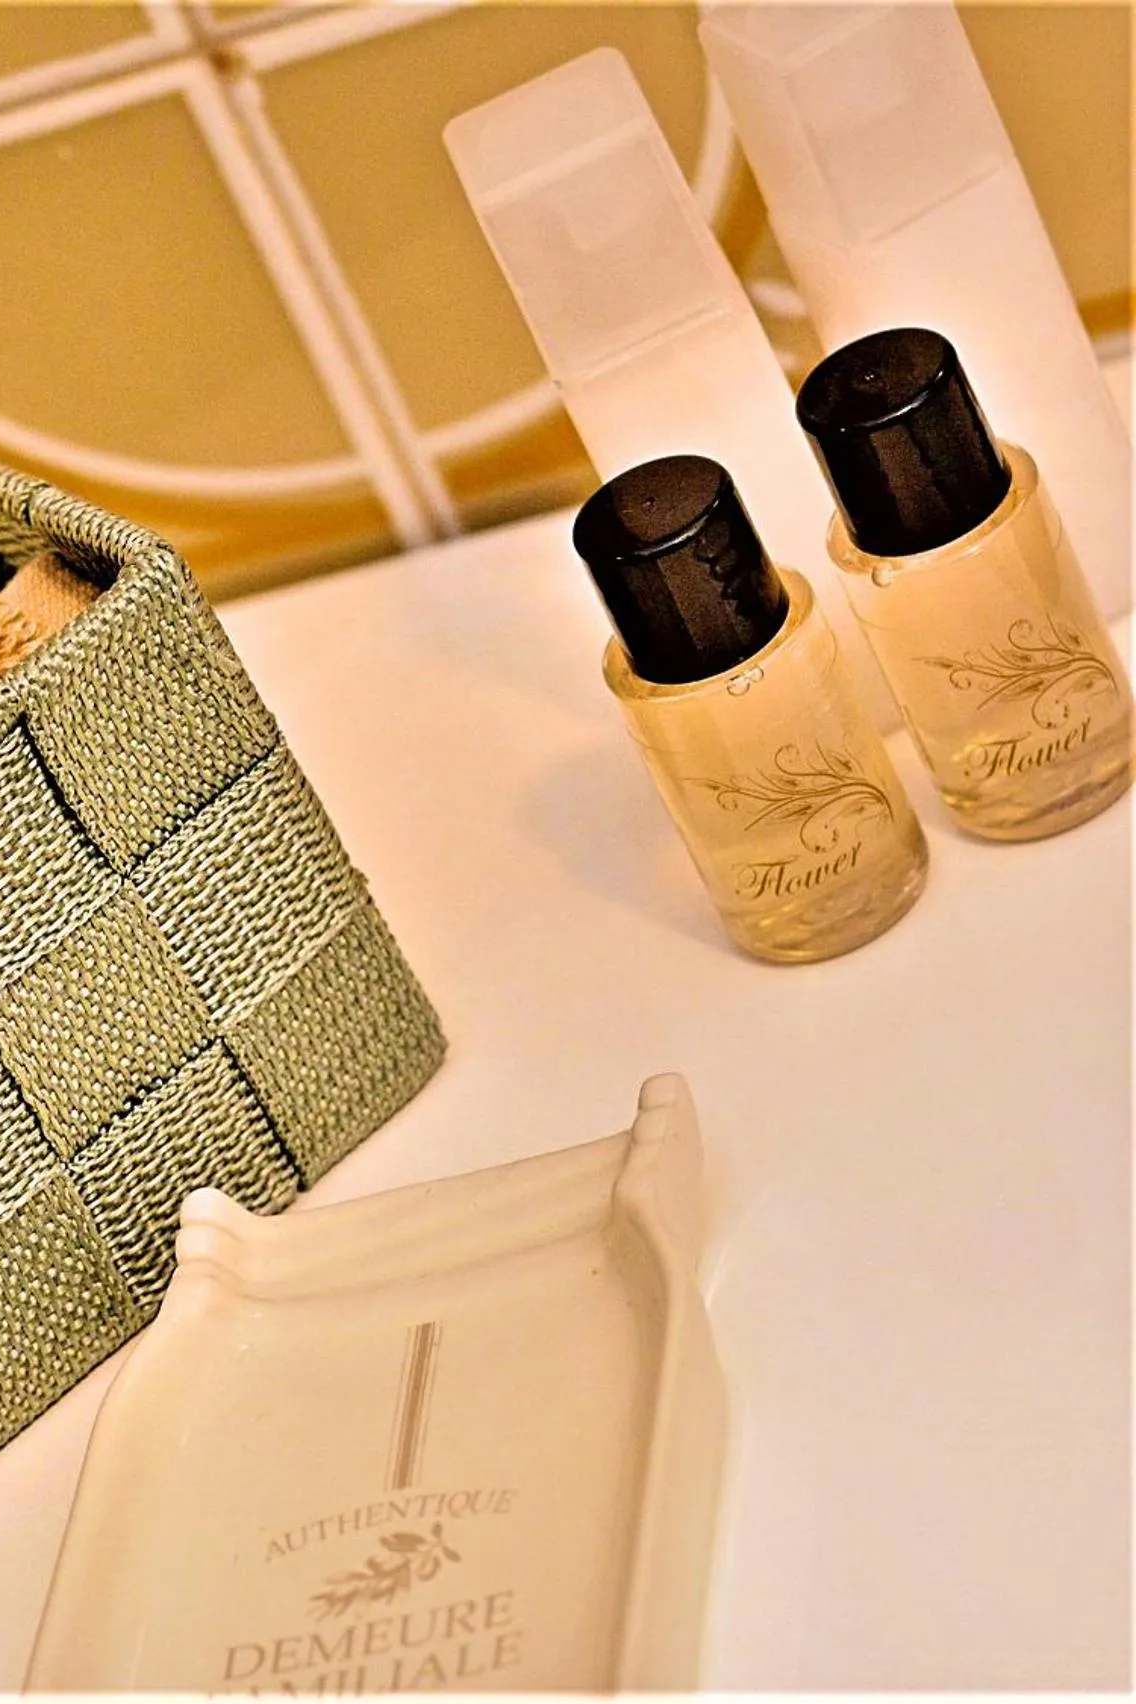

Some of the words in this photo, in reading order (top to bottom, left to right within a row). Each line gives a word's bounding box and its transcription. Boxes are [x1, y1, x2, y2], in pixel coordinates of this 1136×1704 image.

[964, 717, 1091, 782] Flower
[730, 841, 862, 899] Flower
[264, 1488, 519, 1563] AUTHENTIQUE
[222, 1589, 517, 1681] DEMEURE
